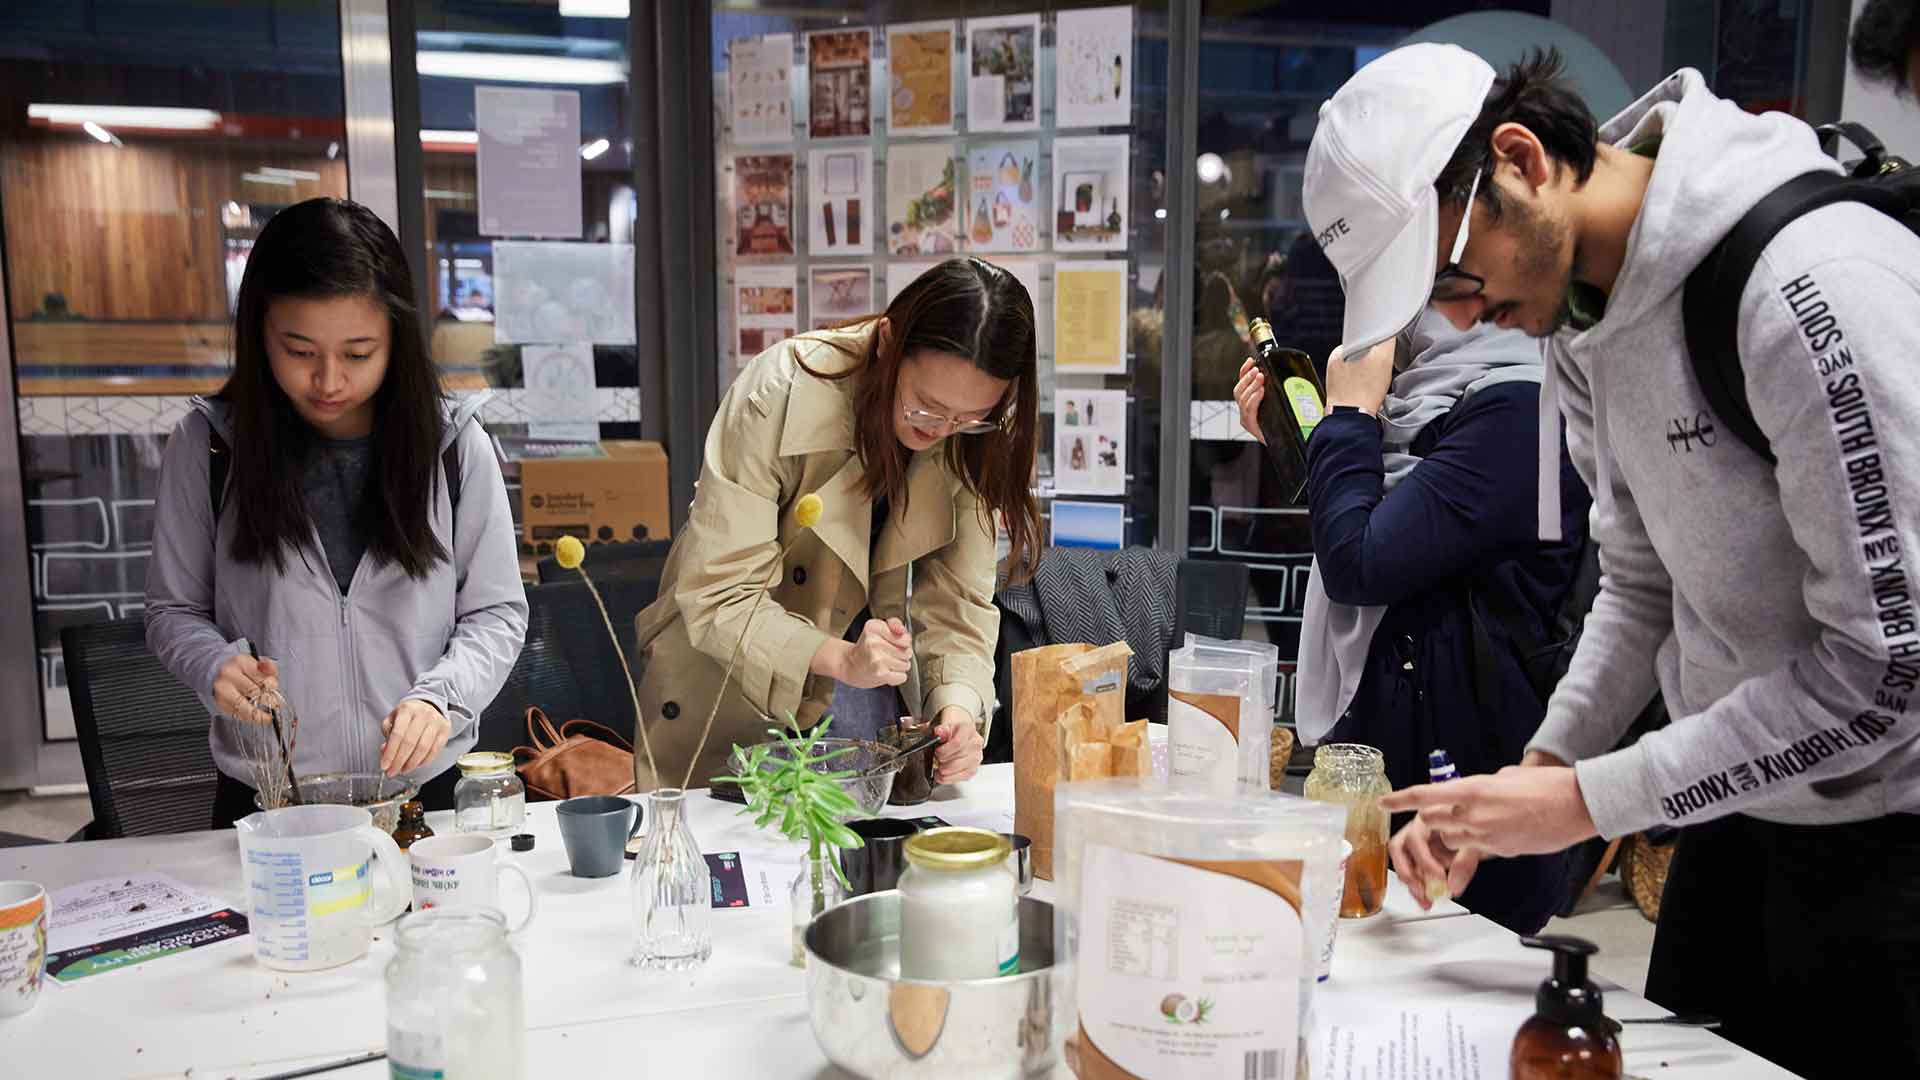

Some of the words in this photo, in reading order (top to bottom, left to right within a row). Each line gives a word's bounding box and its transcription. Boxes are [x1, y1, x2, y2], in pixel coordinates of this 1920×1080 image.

[1317, 217, 1351, 248] OSTE
[1781, 273, 1843, 352] SOUTH
[1818, 346, 1853, 376] NYC
[1826, 373, 1878, 454] SOUTH
[1846, 452, 1896, 537] BRONX
[1863, 535, 1900, 561] NYC
[1870, 559, 1916, 638] BRONX
[1754, 733, 1834, 784] BRONX
[1661, 771, 1738, 820] BRONX
